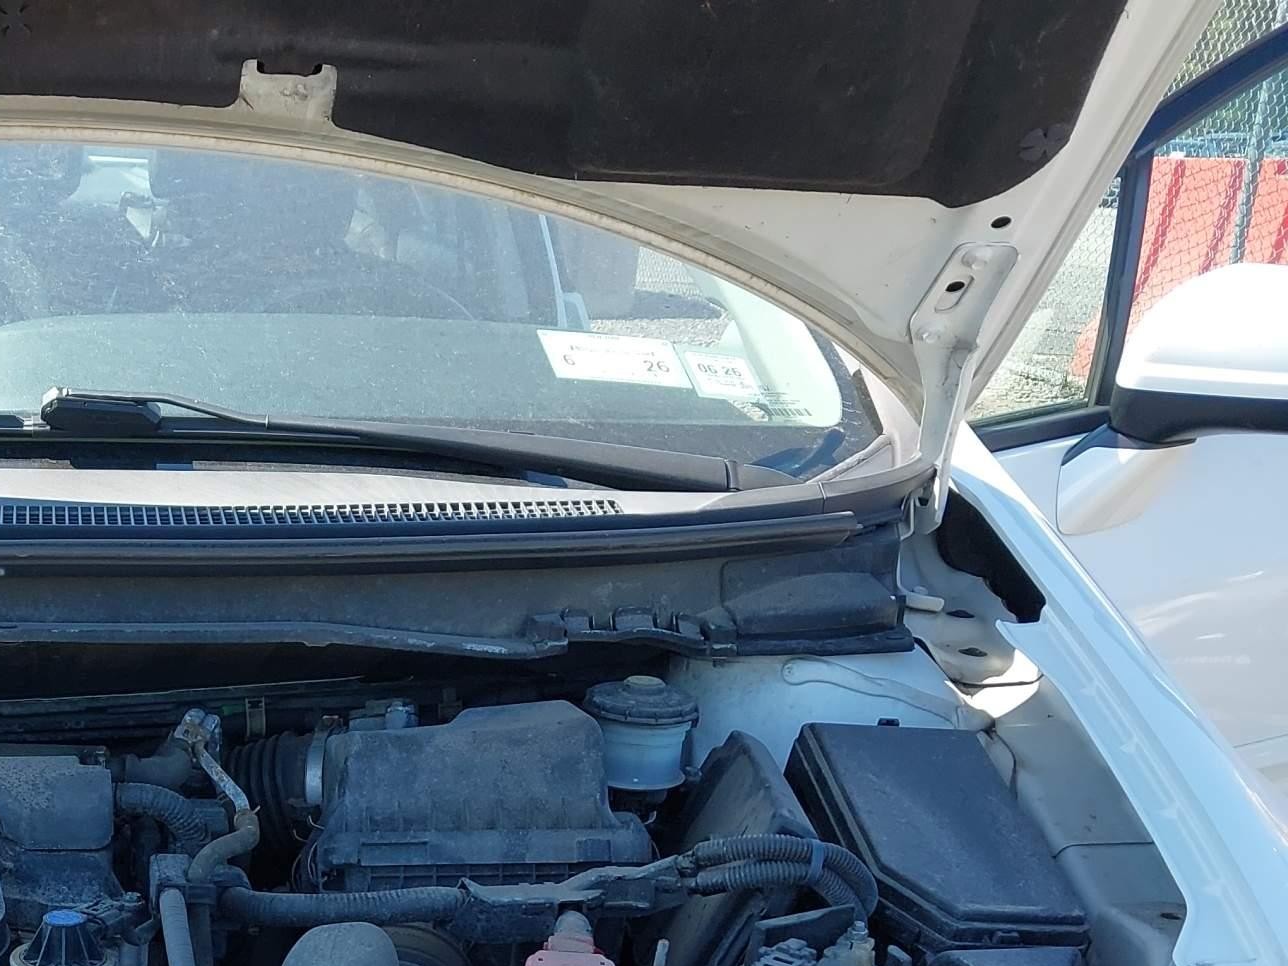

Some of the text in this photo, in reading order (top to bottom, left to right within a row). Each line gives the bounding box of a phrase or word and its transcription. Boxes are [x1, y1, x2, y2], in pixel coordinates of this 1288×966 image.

[562, 353, 671, 374] 6 26
[697, 362, 742, 377] 06 26
